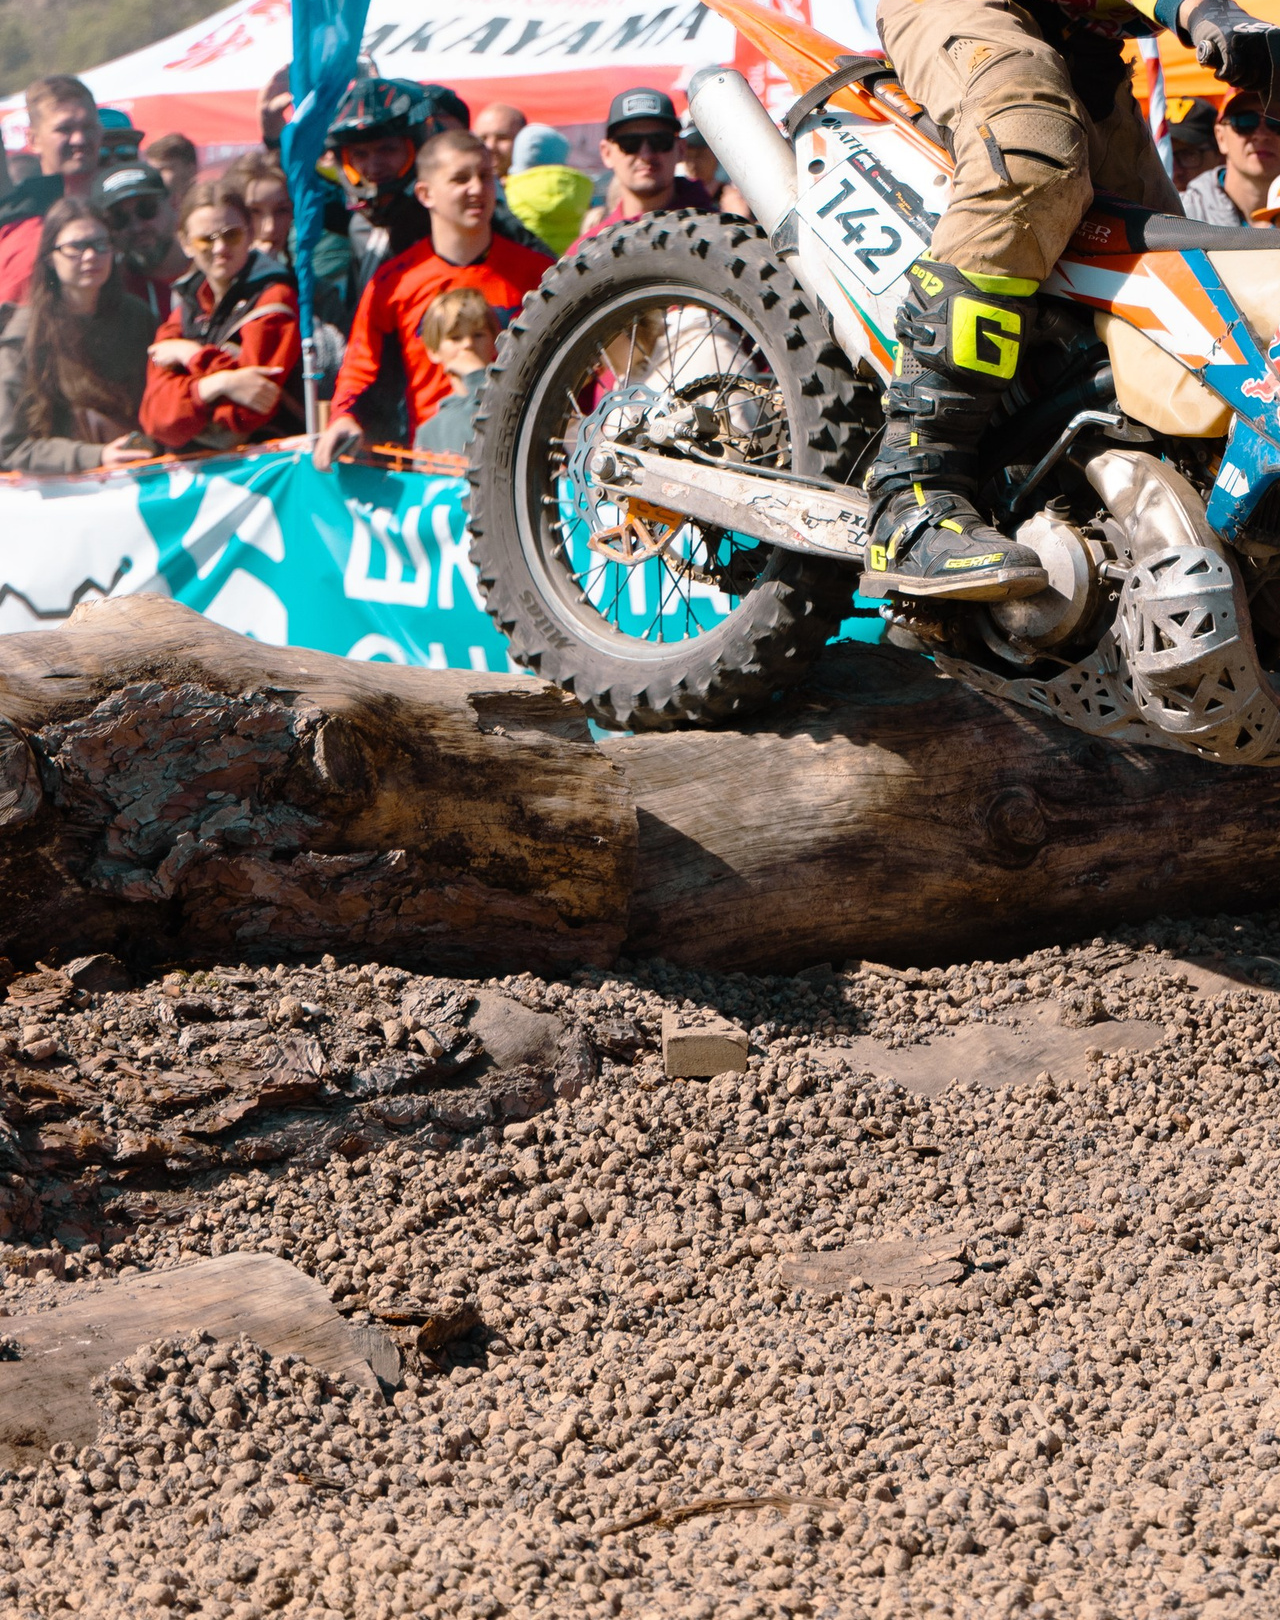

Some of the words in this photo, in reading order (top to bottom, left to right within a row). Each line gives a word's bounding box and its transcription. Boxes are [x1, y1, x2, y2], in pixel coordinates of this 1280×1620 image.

[816, 177, 902, 275] 142
[952, 296, 1022, 380] G
[870, 544, 887, 572] G
